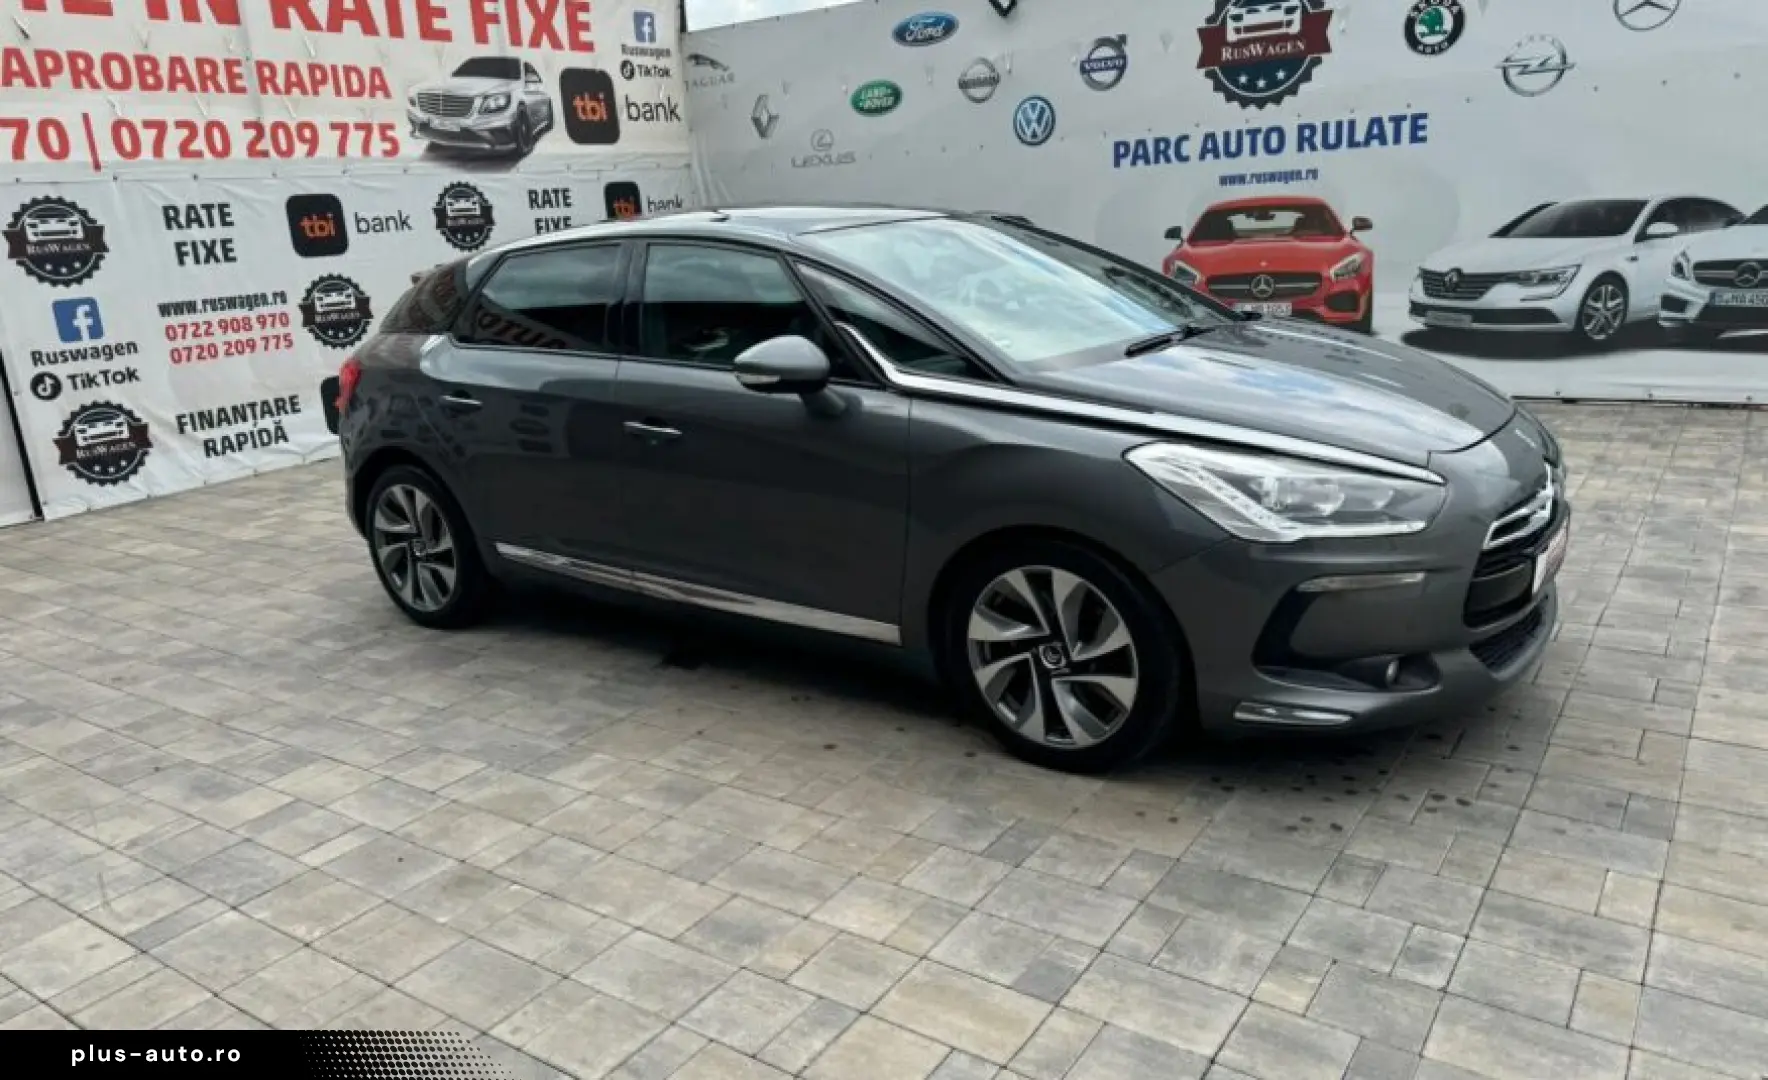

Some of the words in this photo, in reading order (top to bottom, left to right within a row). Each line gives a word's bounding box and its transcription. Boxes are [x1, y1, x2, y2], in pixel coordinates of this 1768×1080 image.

[469, 0, 595, 53] FIXE
[1, 47, 248, 94] APROBARE
[255, 59, 393, 99] RAPIDA
[636, 64, 672, 78] TikTok
[572, 92, 609, 122] tbi
[625, 94, 682, 123] bank
[110, 118, 232, 160] 0720
[242, 120, 320, 159] 209
[329, 122, 401, 158] 775
[1112, 134, 1191, 168] PARC
[1198, 124, 1286, 162] AUTO
[1296, 112, 1429, 153] RULATE
[1218, 168, 1319, 188] www.ruswagen.ro
[527, 187, 573, 210] RATE
[161, 202, 236, 231] RATE
[299, 212, 337, 238] tbi
[354, 210, 413, 235] bank
[174, 237, 238, 267] FIXE
[157, 290, 288, 318] www.ruswagen.ro
[164, 318, 214, 342] 0722
[217, 314, 253, 335] 908
[256, 311, 290, 330] 970
[31, 341, 139, 367] Ruswagen
[169, 342, 219, 366] 0720
[222, 337, 258, 358] 209
[262, 332, 294, 351] 775
[66, 366, 141, 391] TikTok
[203, 421, 290, 459] RAPIDĂ
